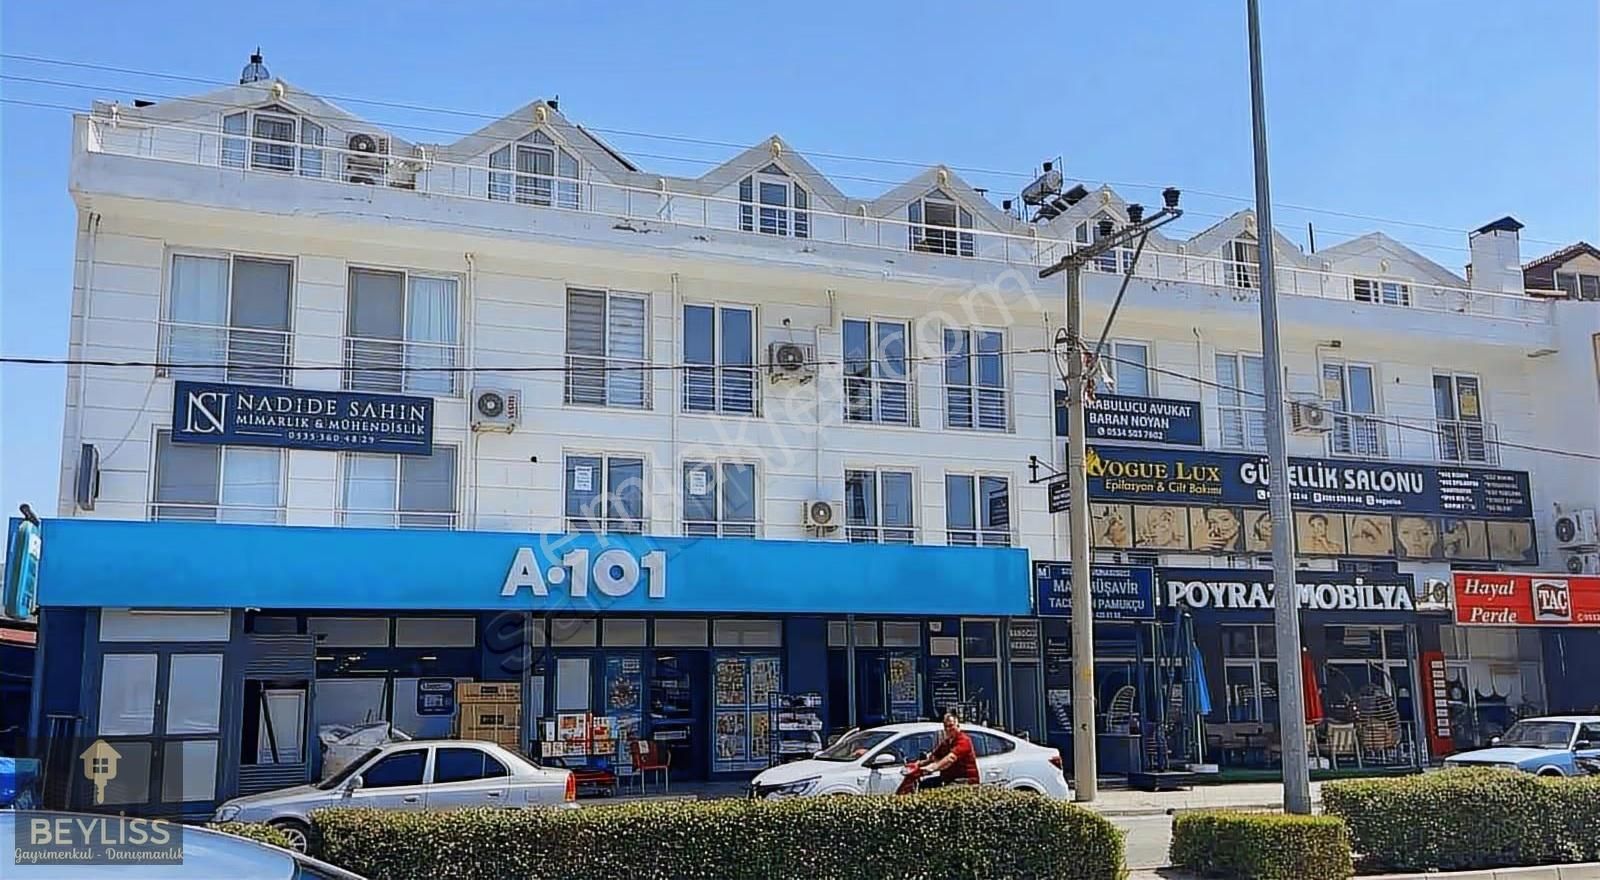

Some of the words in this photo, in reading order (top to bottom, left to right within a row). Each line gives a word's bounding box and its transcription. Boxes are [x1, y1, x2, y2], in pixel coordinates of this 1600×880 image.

[1149, 403, 1193, 417] AVUKAT
[1089, 412, 1129, 426] BARAN
[1131, 415, 1170, 429] NOYAN
[1240, 457, 1338, 489] GÜELLİK
[1343, 468, 1423, 493] SALONU
[1105, 479, 1154, 493] Epilasyon
[1156, 481, 1165, 493] &
[1296, 577, 1415, 611] MOBİLYA
[1464, 578, 1515, 601] Hayal
[1098, 598, 1145, 613] PAMUKÇU
[1538, 589, 1568, 615] TAÇ
[1470, 607, 1517, 623] Perde
